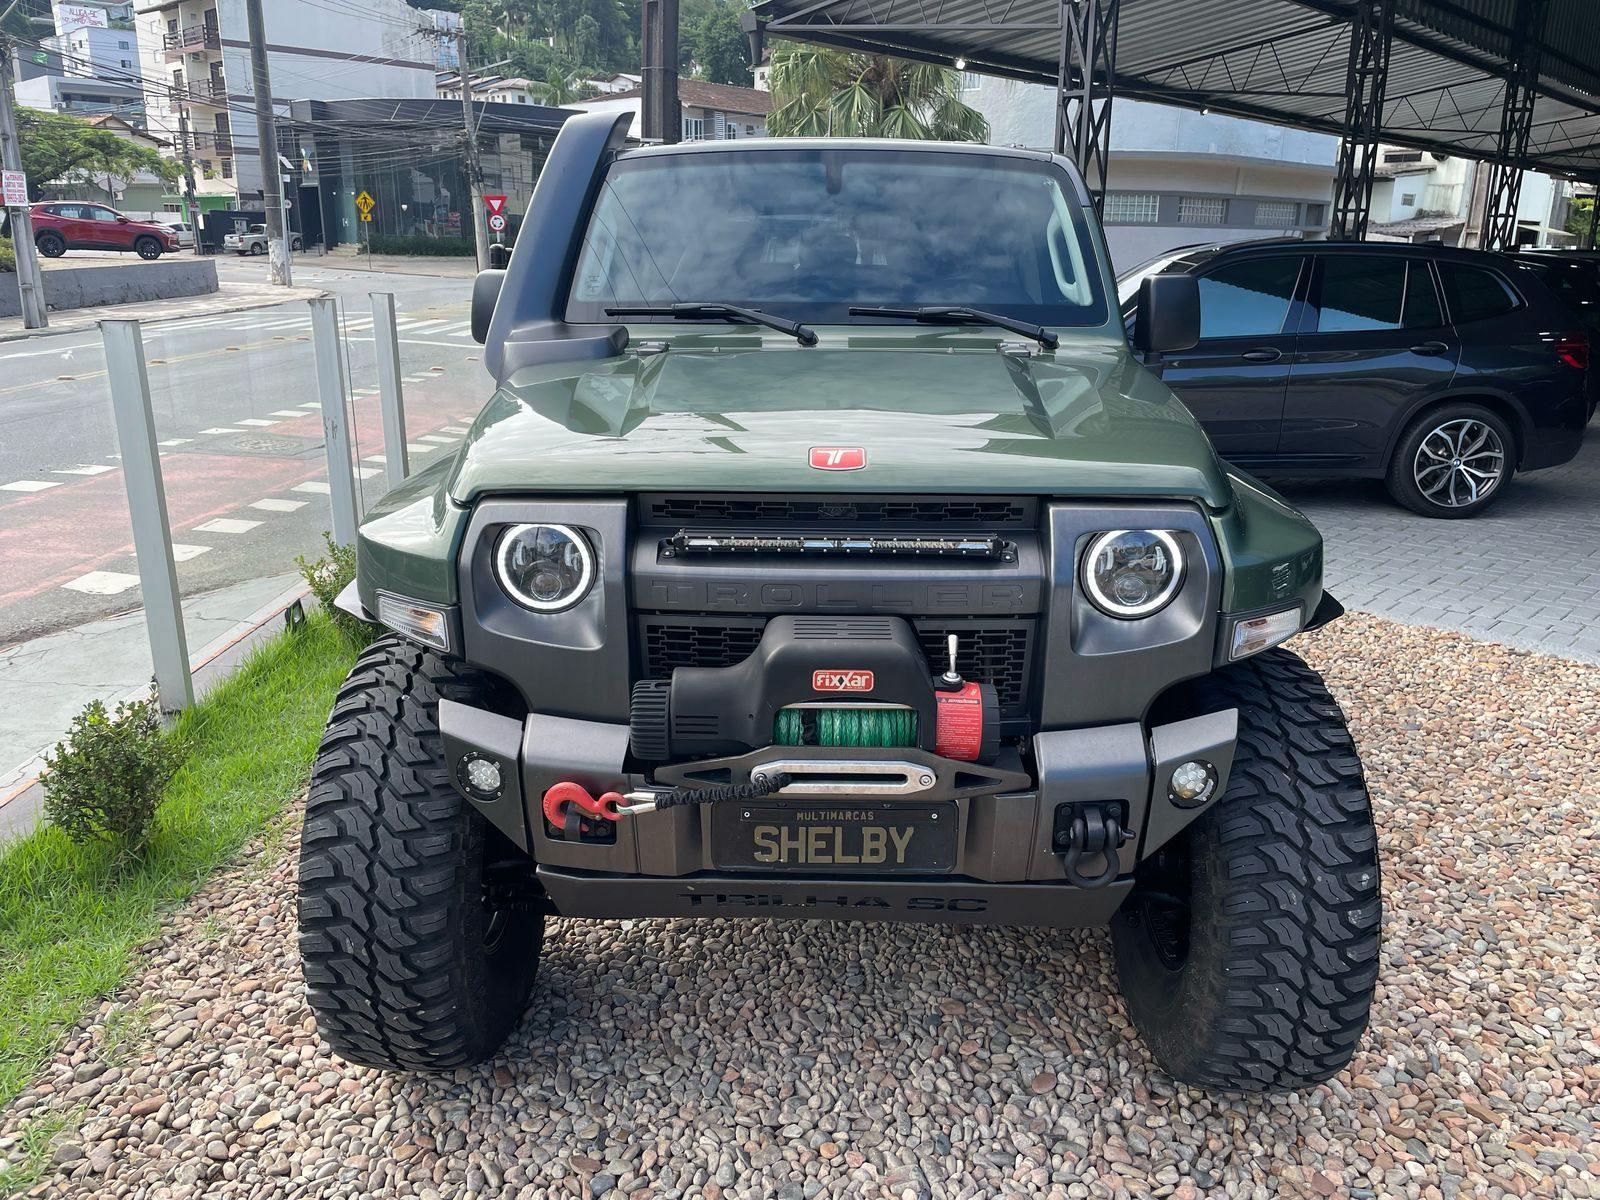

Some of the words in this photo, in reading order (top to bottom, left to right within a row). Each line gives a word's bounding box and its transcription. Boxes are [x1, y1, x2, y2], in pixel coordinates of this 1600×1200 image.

[651, 580, 1024, 608] TROLLER
[796, 811, 875, 821] MULTIMARCAS
[753, 825, 915, 864] SHELBY
[676, 893, 892, 908] TRILHA
[906, 896, 988, 913] SC
